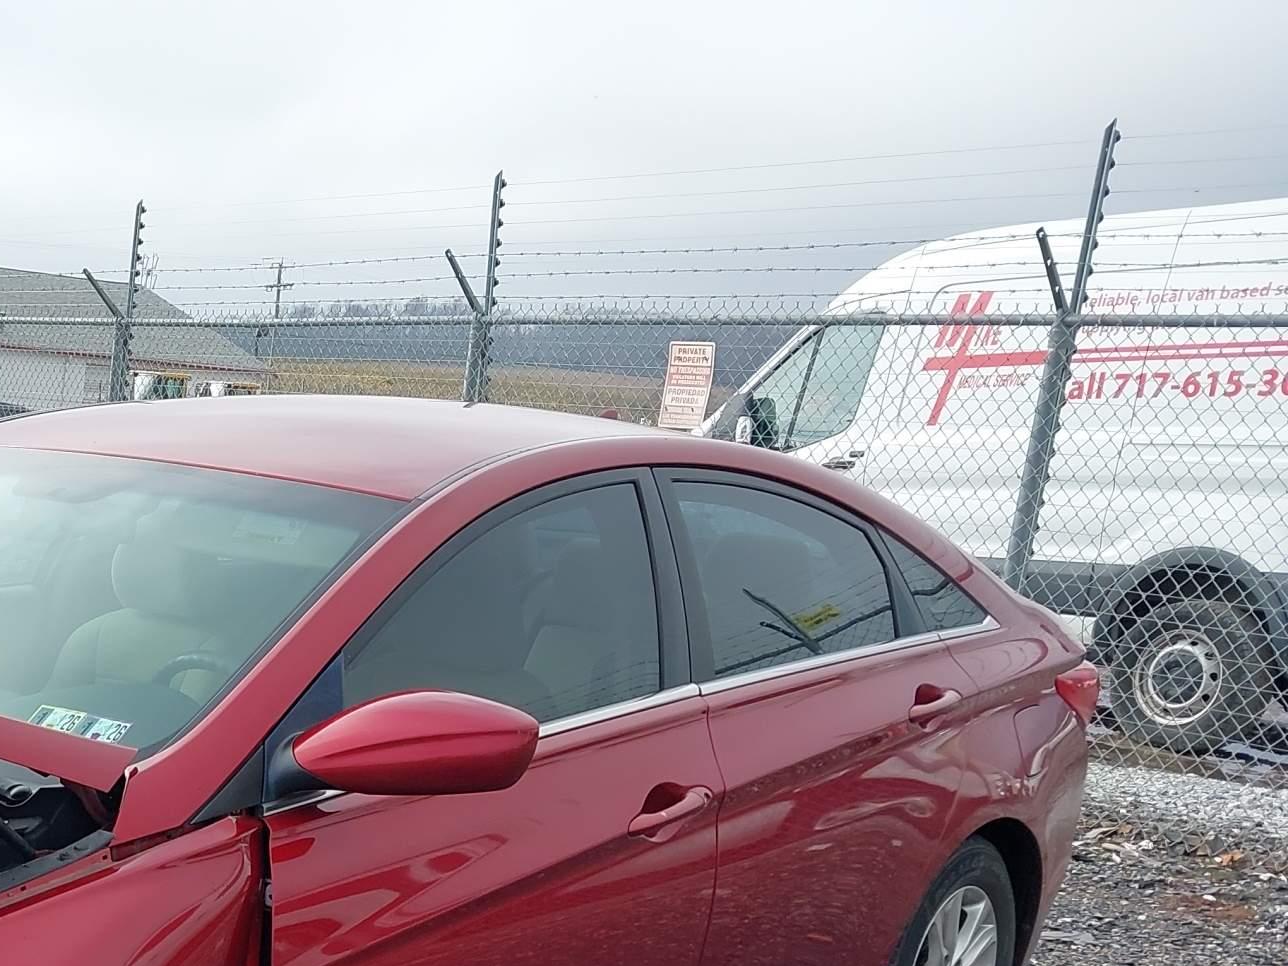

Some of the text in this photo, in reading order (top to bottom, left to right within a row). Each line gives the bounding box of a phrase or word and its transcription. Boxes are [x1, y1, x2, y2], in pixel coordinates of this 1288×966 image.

[1085, 293, 1141, 308] eliable,
[1146, 288, 1182, 305] local
[1187, 290, 1215, 302] van
[1220, 282, 1272, 300] based
[678, 347, 707, 355] PRIVATE
[673, 355, 710, 364] PROPERTY
[1068, 371, 1107, 400] all
[668, 388, 706, 397] PROPIEDAD
[106, 723, 128, 741] 26
